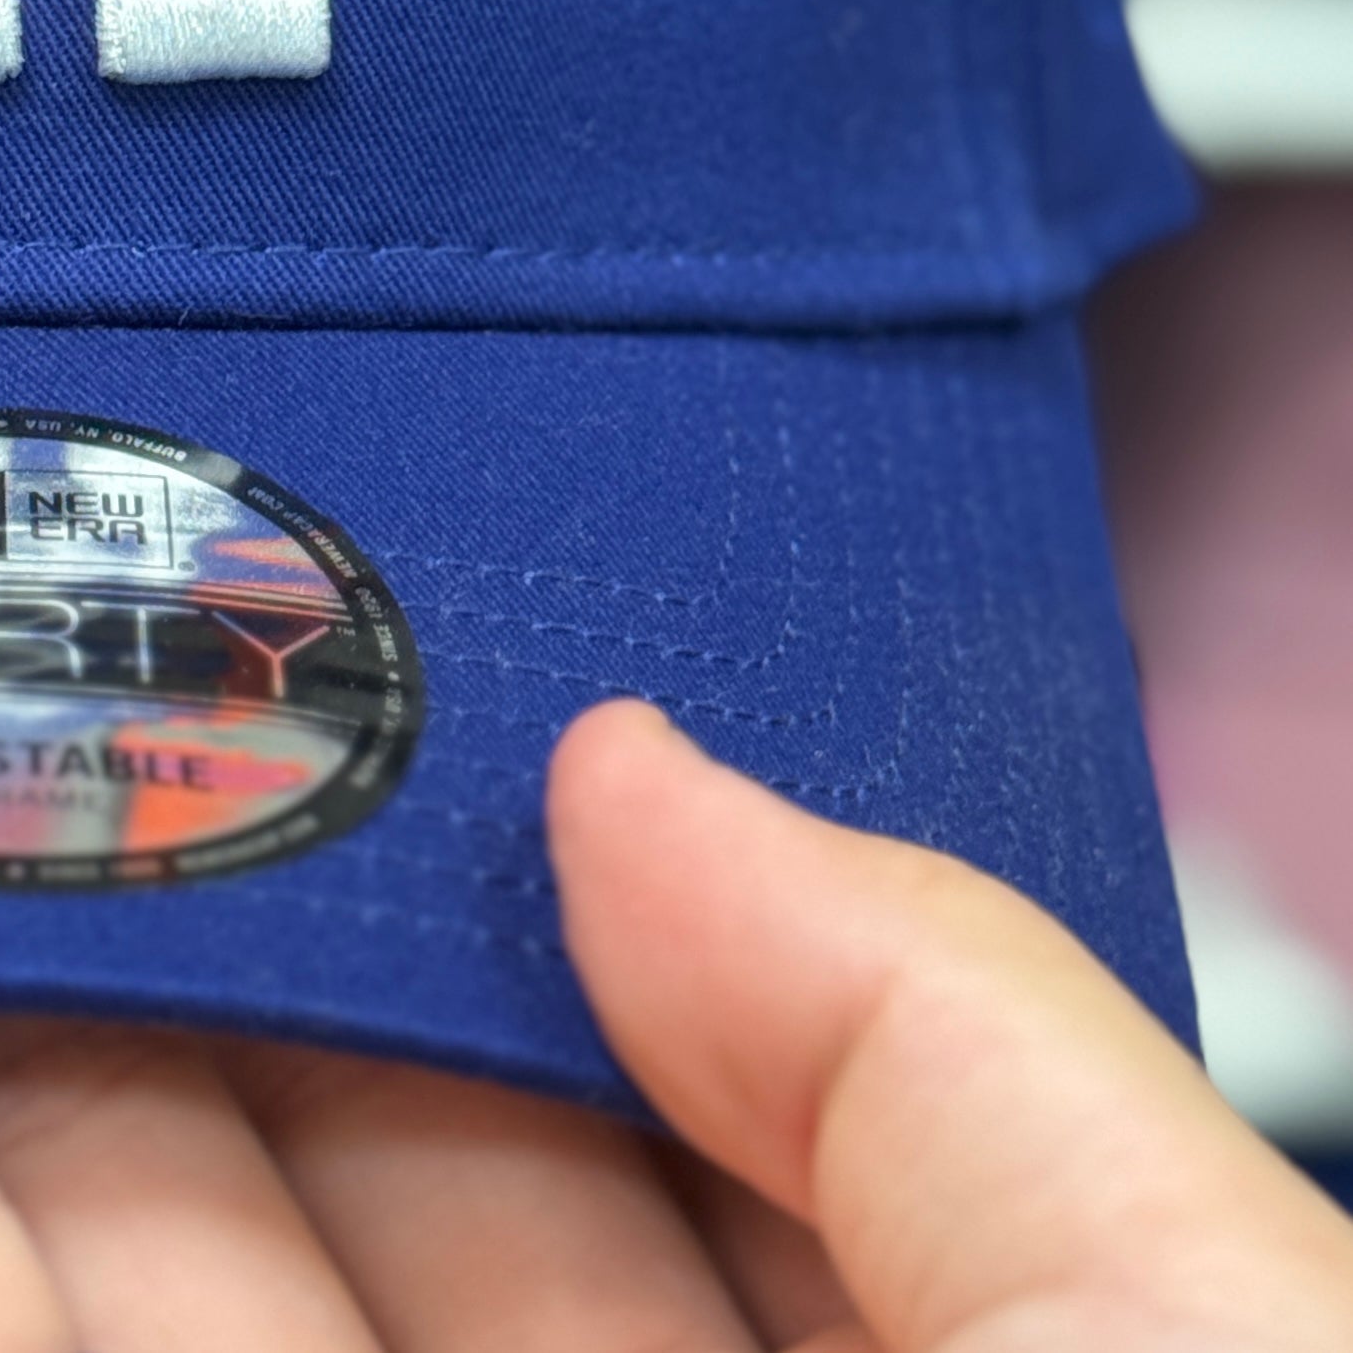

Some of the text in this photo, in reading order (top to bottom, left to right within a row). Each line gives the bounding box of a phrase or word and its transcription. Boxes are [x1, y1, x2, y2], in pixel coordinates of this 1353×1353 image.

[25, 419, 61, 432] USA
[28, 490, 145, 518] NEW
[29, 516, 149, 545] ERA
